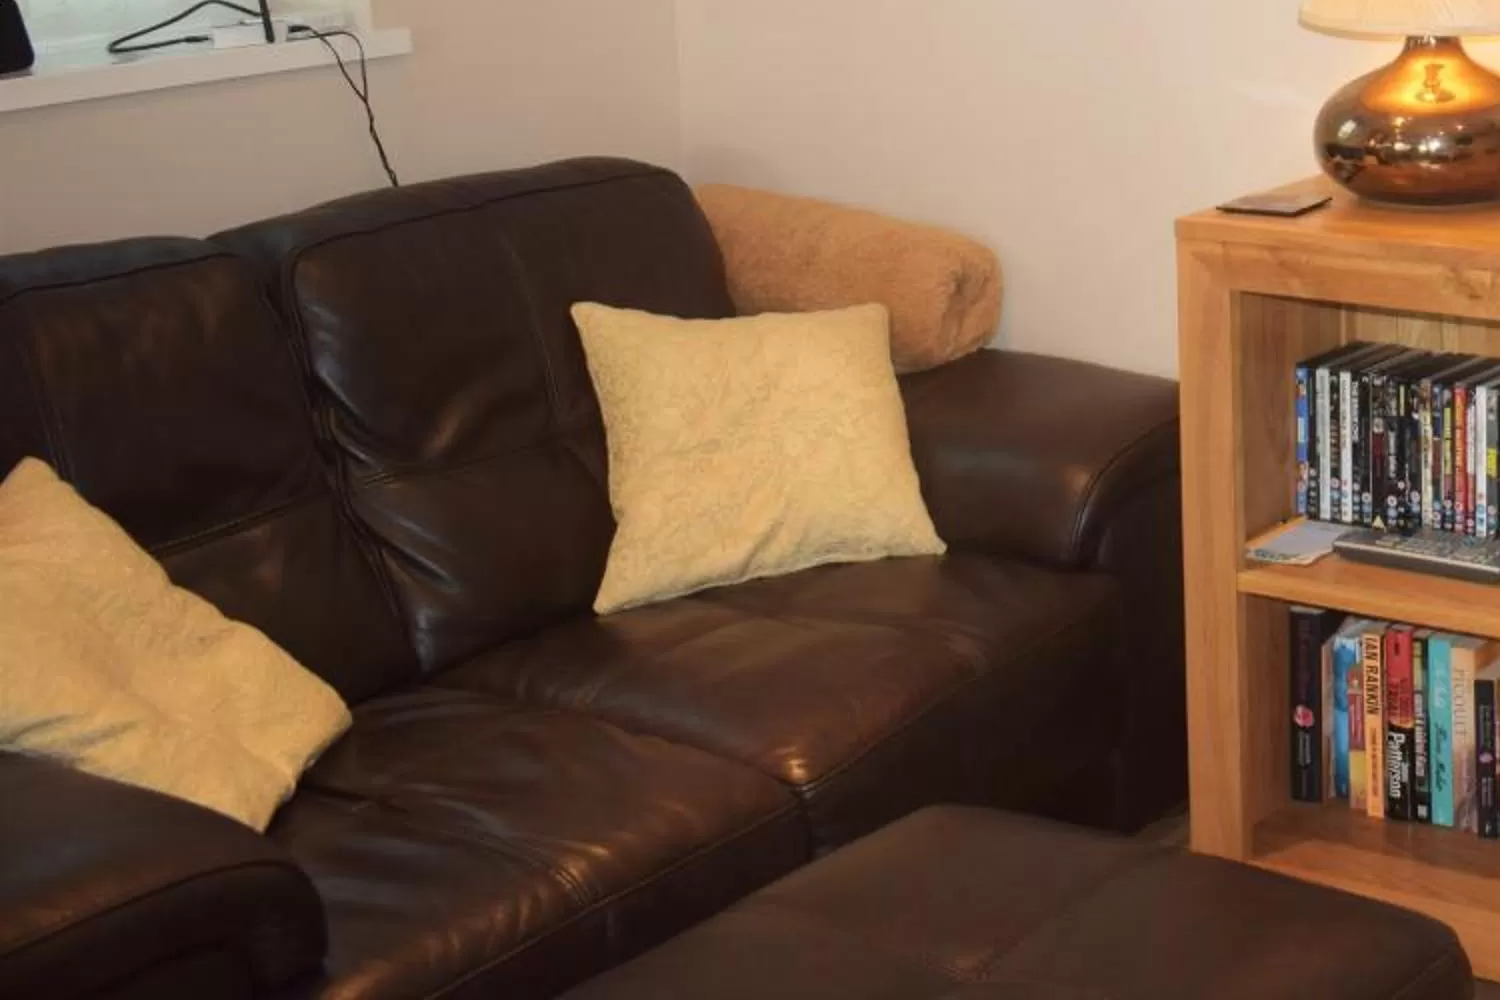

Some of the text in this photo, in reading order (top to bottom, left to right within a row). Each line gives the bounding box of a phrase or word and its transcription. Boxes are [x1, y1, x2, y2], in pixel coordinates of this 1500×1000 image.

[1364, 637, 1380, 661] IAN
[1365, 664, 1381, 716] RANKIN
[1388, 731, 1405, 799] Patterson
